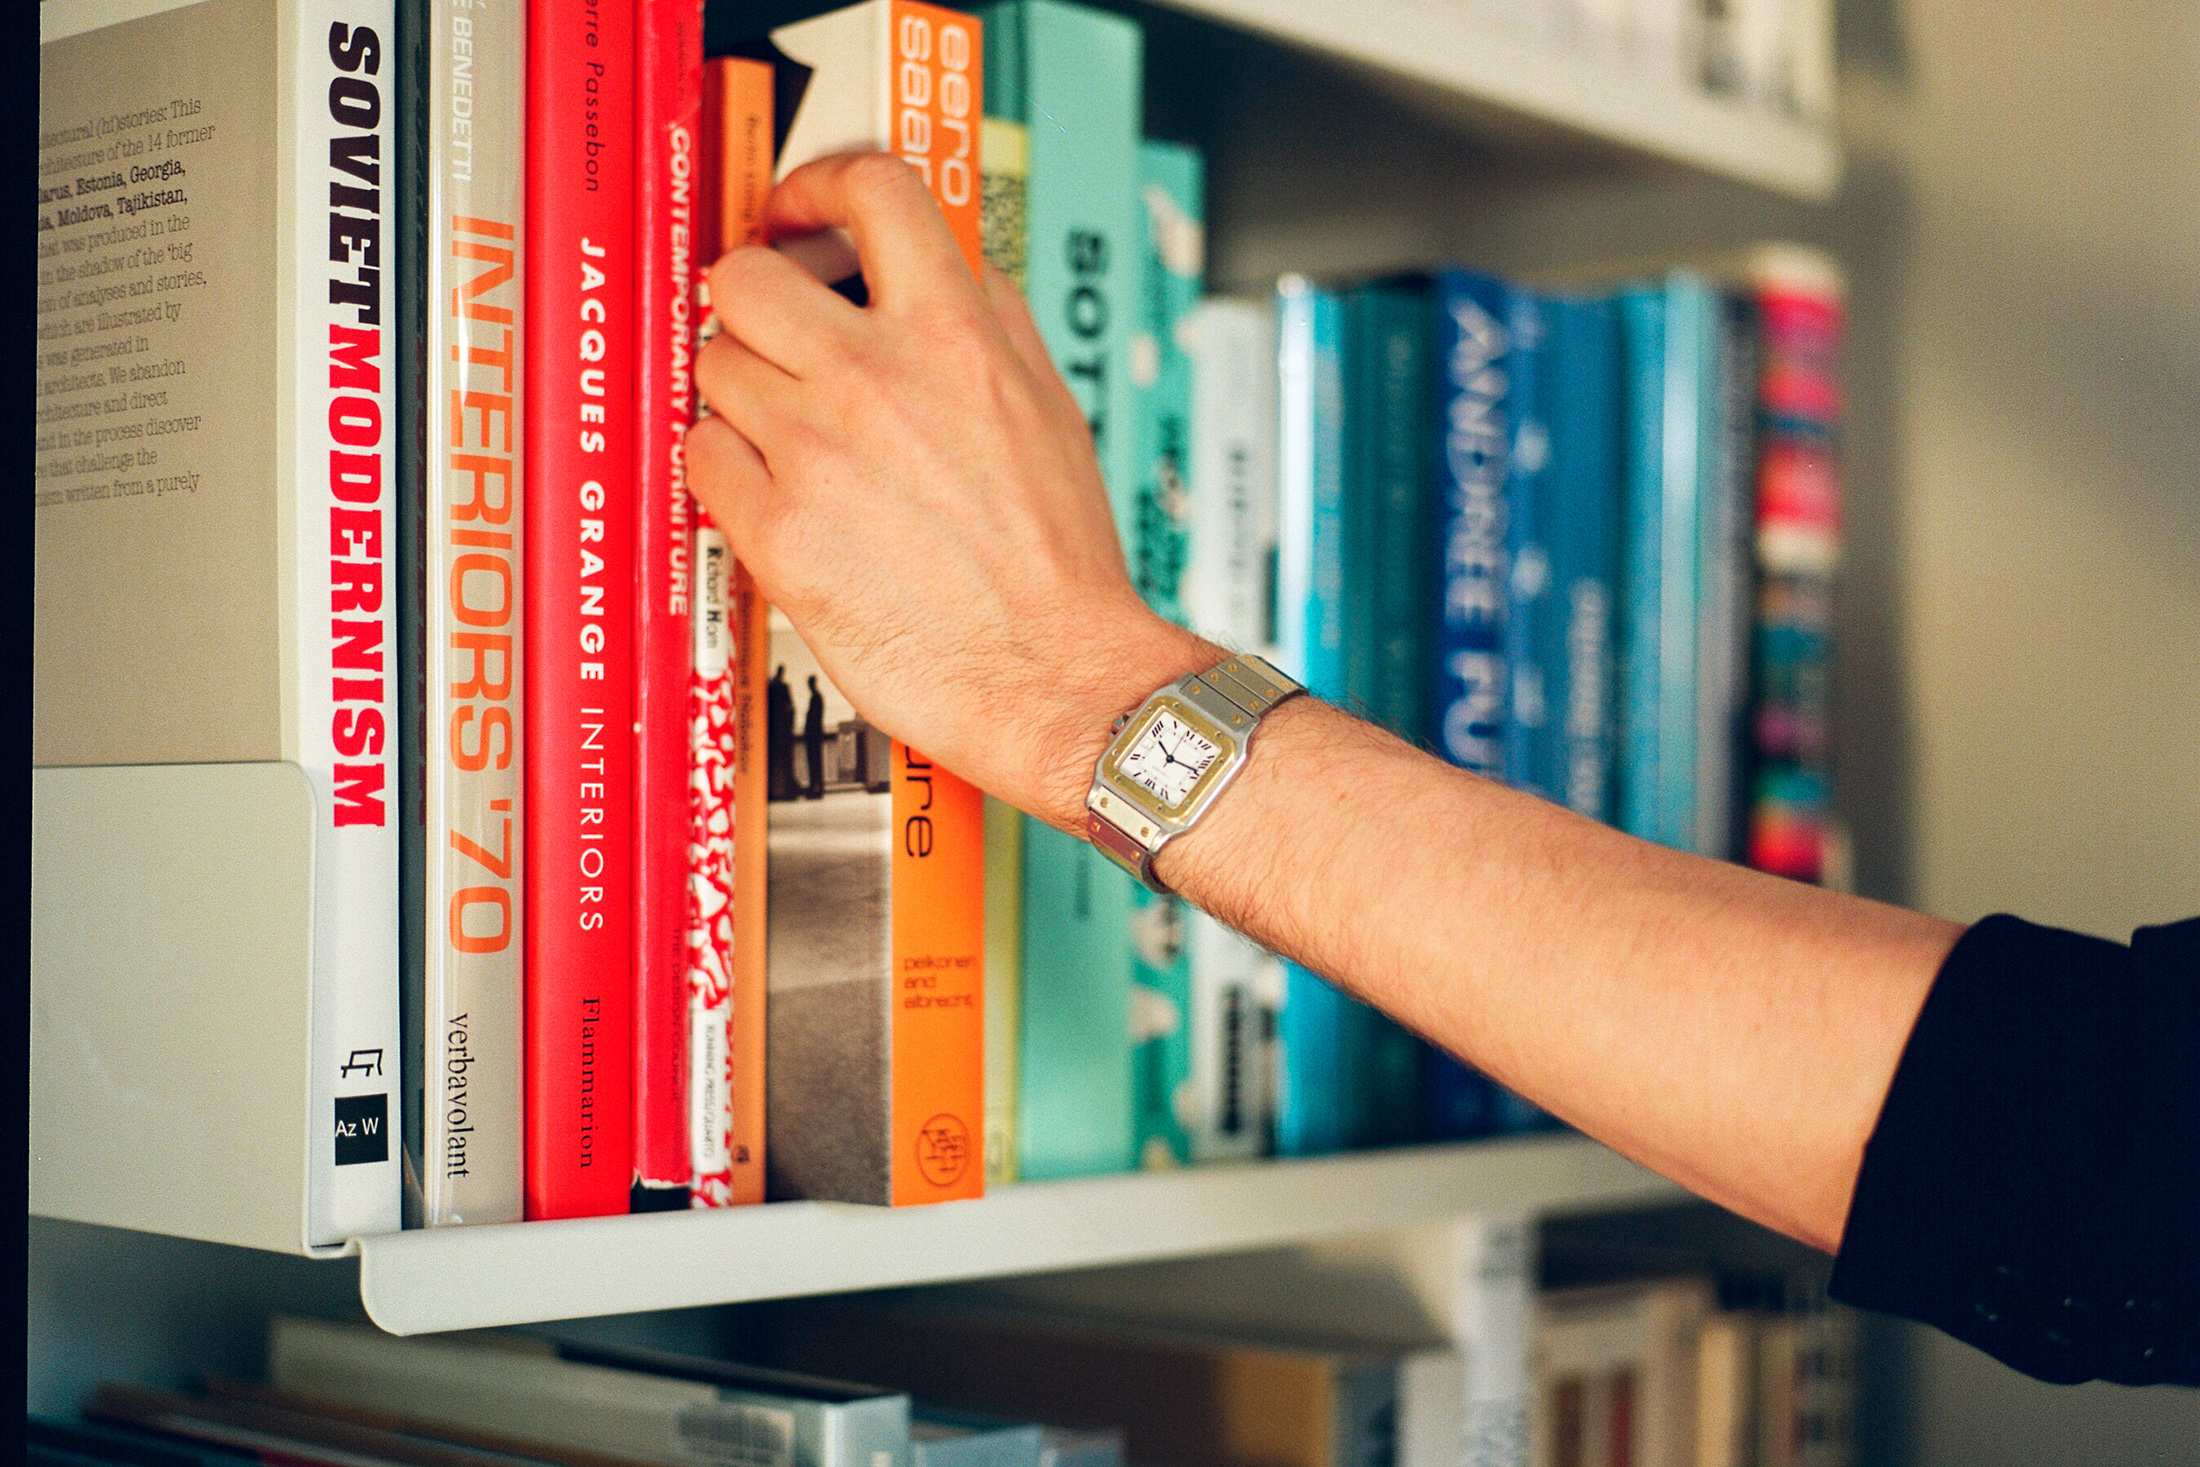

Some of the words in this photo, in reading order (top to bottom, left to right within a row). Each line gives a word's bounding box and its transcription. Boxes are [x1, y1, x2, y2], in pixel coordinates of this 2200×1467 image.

[170, 98, 202, 119] This
[452, 18, 473, 182] BENEDETTI
[939, 24, 971, 208] eero
[122, 139, 144, 158] the
[148, 133, 162, 152] 14
[166, 125, 216, 149] former
[586, 61, 605, 192] Passebon
[76, 171, 127, 196] Estonia,
[130, 159, 186, 184] Georgia,
[58, 204, 114, 228] Moldova,
[117, 188, 188, 217] Tajikistan,
[88, 220, 147, 254] produced
[150, 220, 165, 237] in
[167, 214, 190, 234] the
[78, 255, 125, 280] shadow
[128, 248, 142, 270] of
[143, 247, 165, 267] the
[669, 127, 692, 417] CONTEMPORARY
[128, 275, 154, 298] and
[96, 302, 162, 332] illustrated
[164, 300, 182, 323] by
[70, 336, 132, 368] generated
[135, 336, 150, 354] in
[580, 237, 606, 453] JACQUES
[130, 359, 187, 383] abandon
[104, 392, 128, 415] and
[130, 390, 169, 411] direct
[95, 423, 144, 449] process
[146, 414, 202, 438] discover
[75, 452, 135, 475] challenge
[137, 447, 158, 468] the
[113, 479, 144, 499] from
[146, 479, 155, 495] a
[157, 470, 201, 498] purely
[449, 214, 514, 772] INTERIORS
[580, 480, 605, 681] GRANGE
[580, 707, 604, 932] INTERIORS
[448, 798, 514, 955] '70
[447, 1012, 475, 1179] verbavolant
[580, 998, 601, 1169] Flammarion
[335, 1118, 357, 1138] Az
[361, 1117, 380, 1136] W
